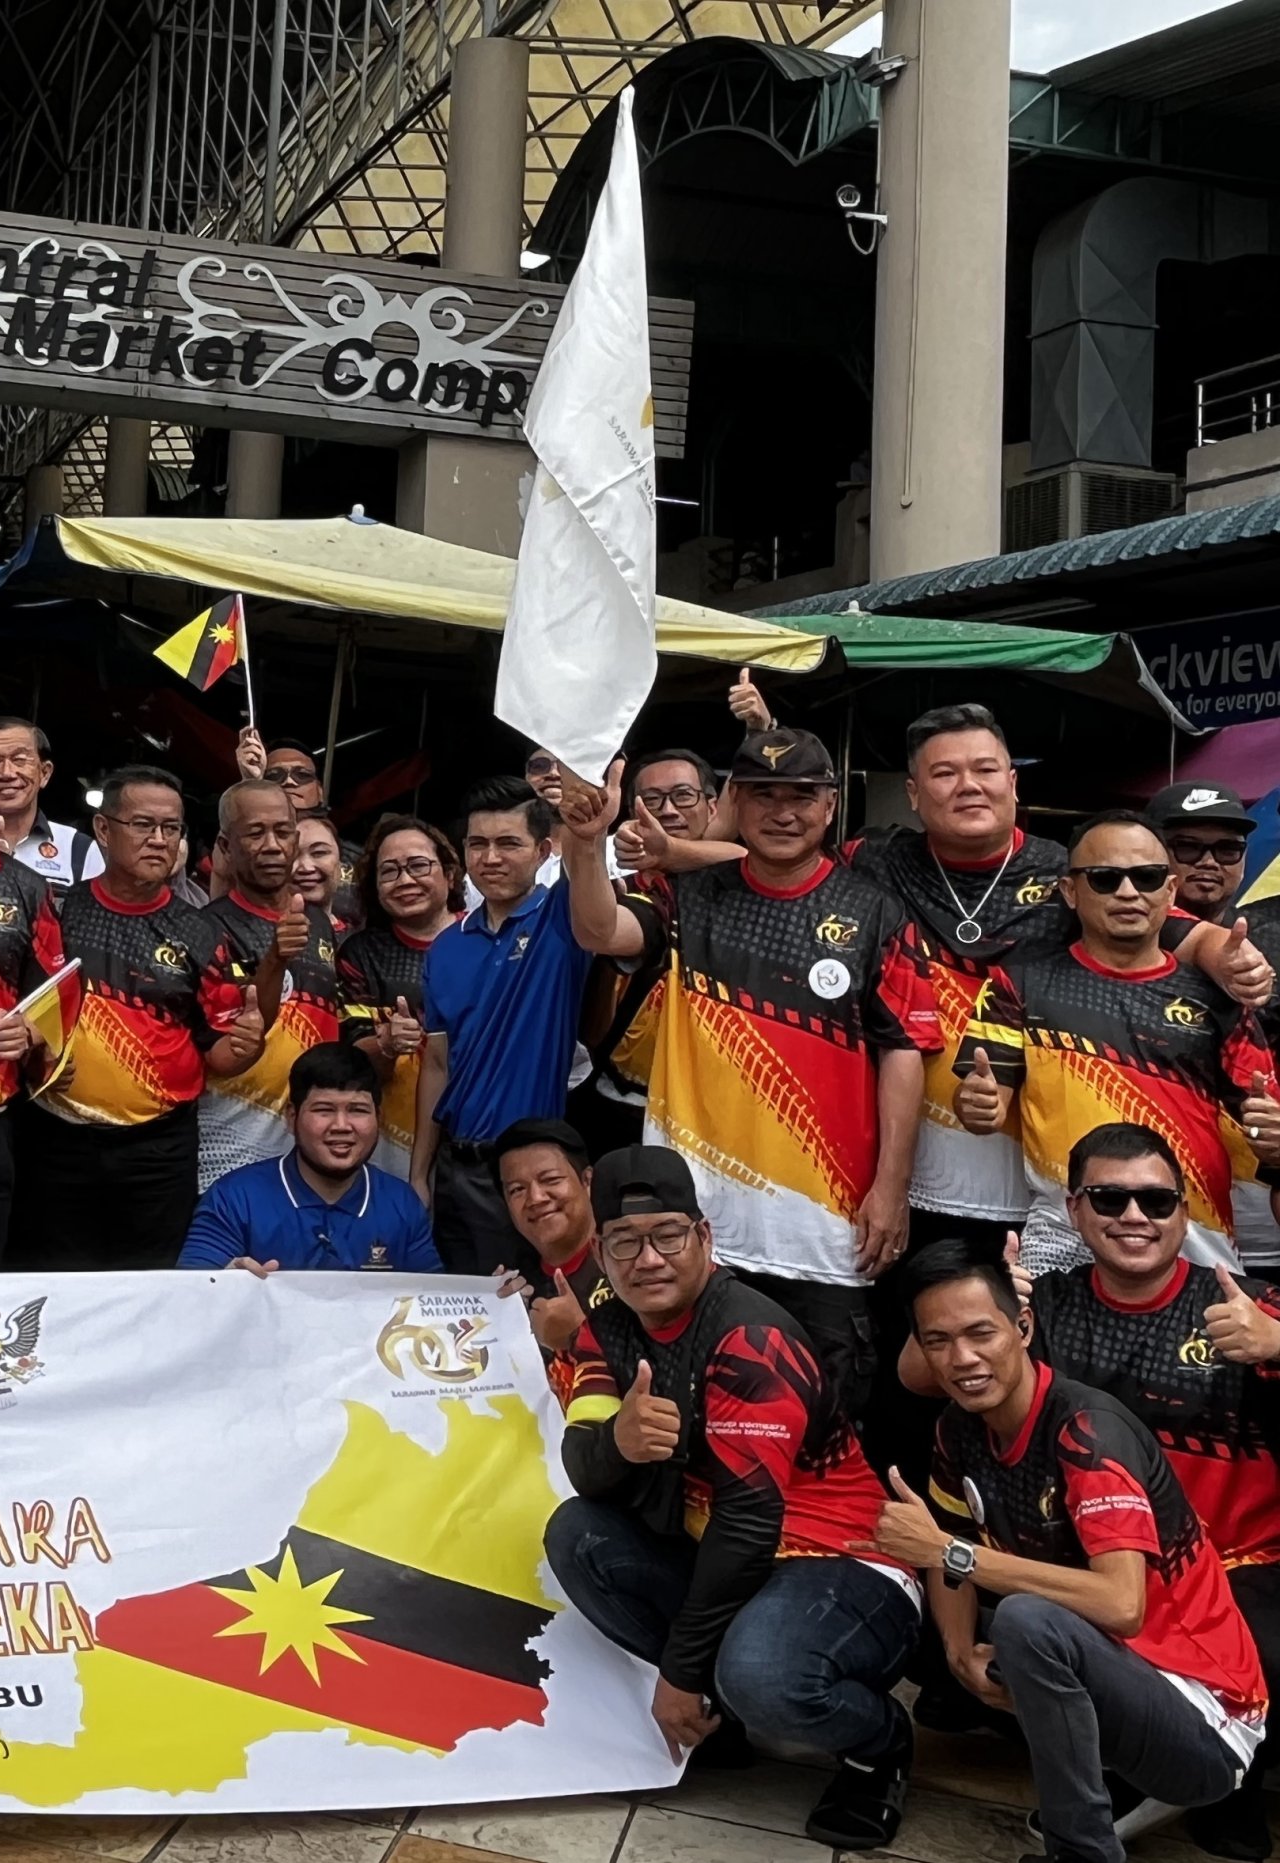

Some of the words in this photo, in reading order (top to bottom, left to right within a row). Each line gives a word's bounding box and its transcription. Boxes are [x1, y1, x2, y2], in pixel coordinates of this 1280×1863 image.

[2, 296, 266, 389] Market
[322, 337, 528, 428] Comp
[1187, 693, 1211, 715] for
